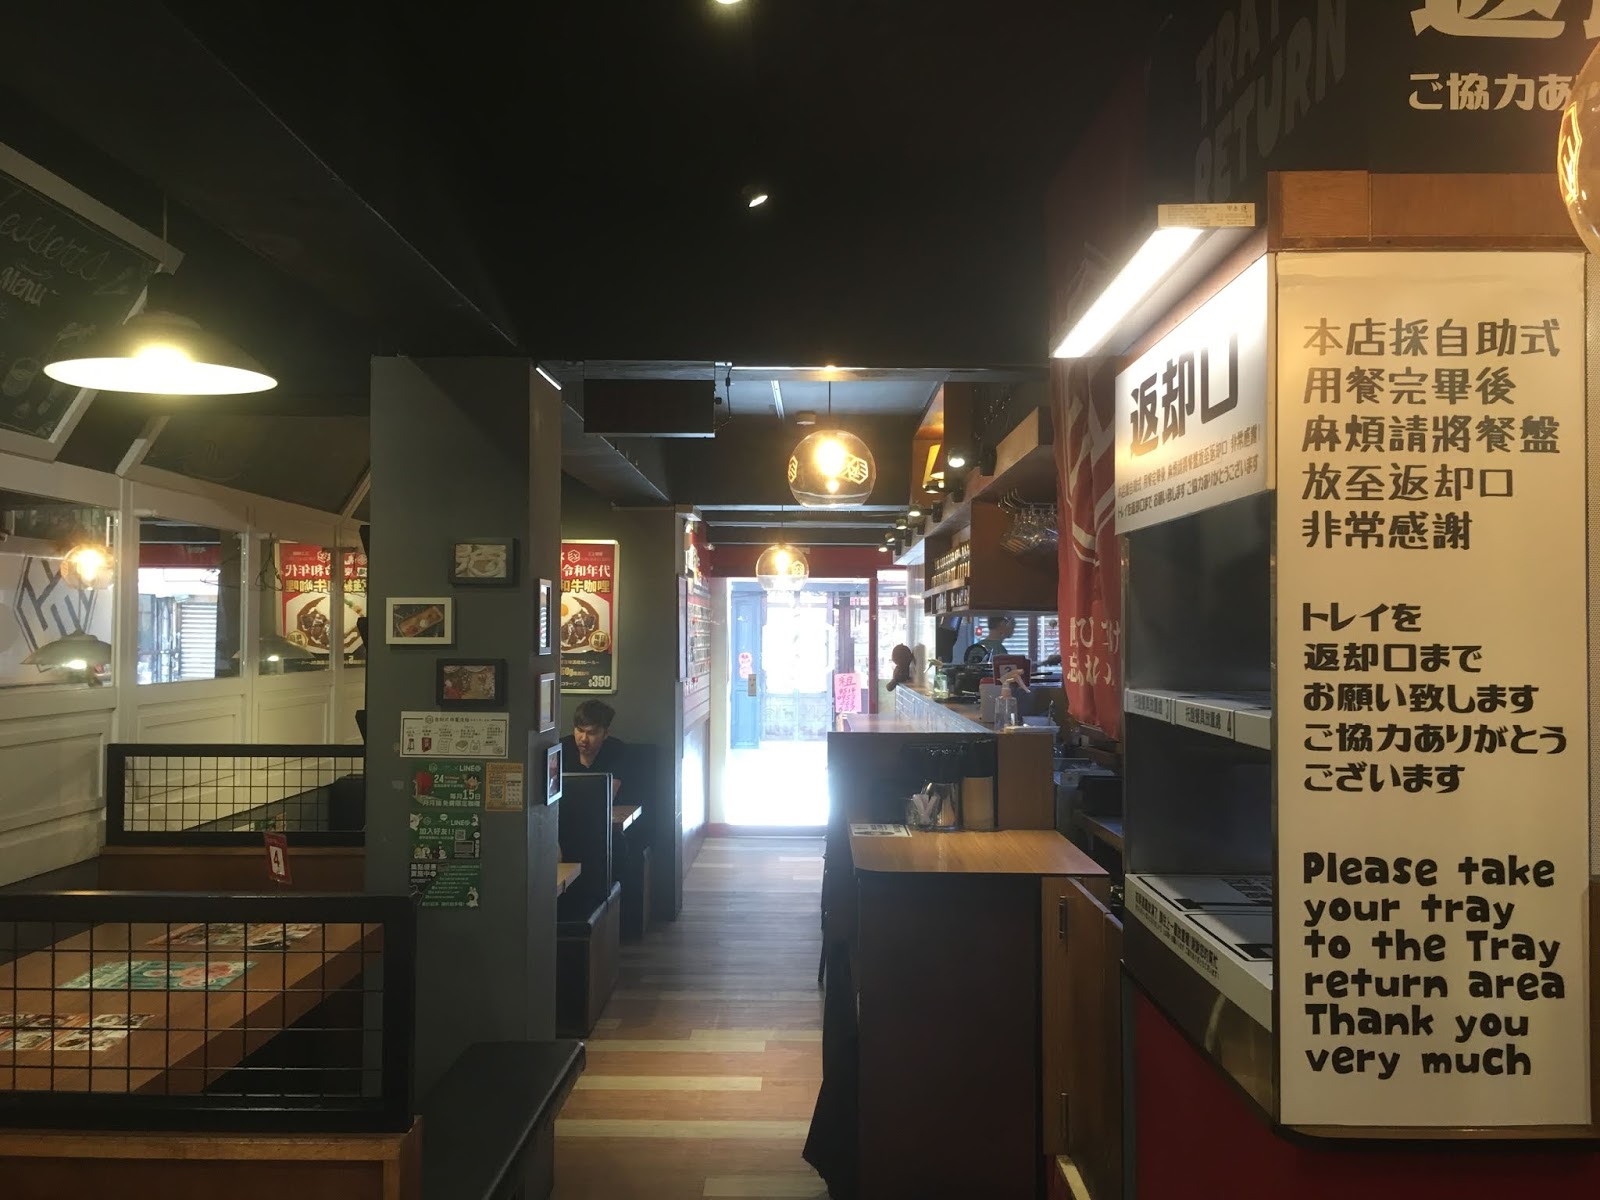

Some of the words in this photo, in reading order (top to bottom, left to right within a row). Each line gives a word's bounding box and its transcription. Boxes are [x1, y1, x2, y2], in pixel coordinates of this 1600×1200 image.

[1409, 73, 1575, 110] ご協力あ
[1303, 318, 1560, 357] 本店採自助式
[1130, 332, 1238, 457] 返却口
[1303, 366, 1516, 404] 用餐完畢後
[1302, 414, 1560, 454] 麻煩請將餐盤
[1302, 462, 1514, 501] 放至返却口
[1302, 510, 1473, 550] 非常感謝
[562, 564, 610, 578] 令和年代
[1302, 602, 1422, 632] トレイを
[1304, 642, 1482, 672] 返却口まで
[588, 675, 611, 687] $350
[1304, 682, 1539, 714] お願い致します
[1304, 722, 1567, 754] ご協力ありがとう
[1304, 762, 1466, 794] ございます
[274, 850, 280, 867] 4
[1304, 852, 1438, 886] Please
[1458, 855, 1555, 888] take
[1304, 898, 1400, 927] your
[1421, 894, 1515, 930] tray
[1304, 930, 1350, 959] to
[1372, 928, 1446, 962] the
[1466, 930, 1560, 968] Tray
[1304, 968, 1448, 998] return
[1468, 970, 1565, 1000] area
[1304, 1003, 1434, 1036] Thank
[1455, 1012, 1528, 1043] you
[1305, 1046, 1400, 1080] very
[1422, 1043, 1532, 1076] much
